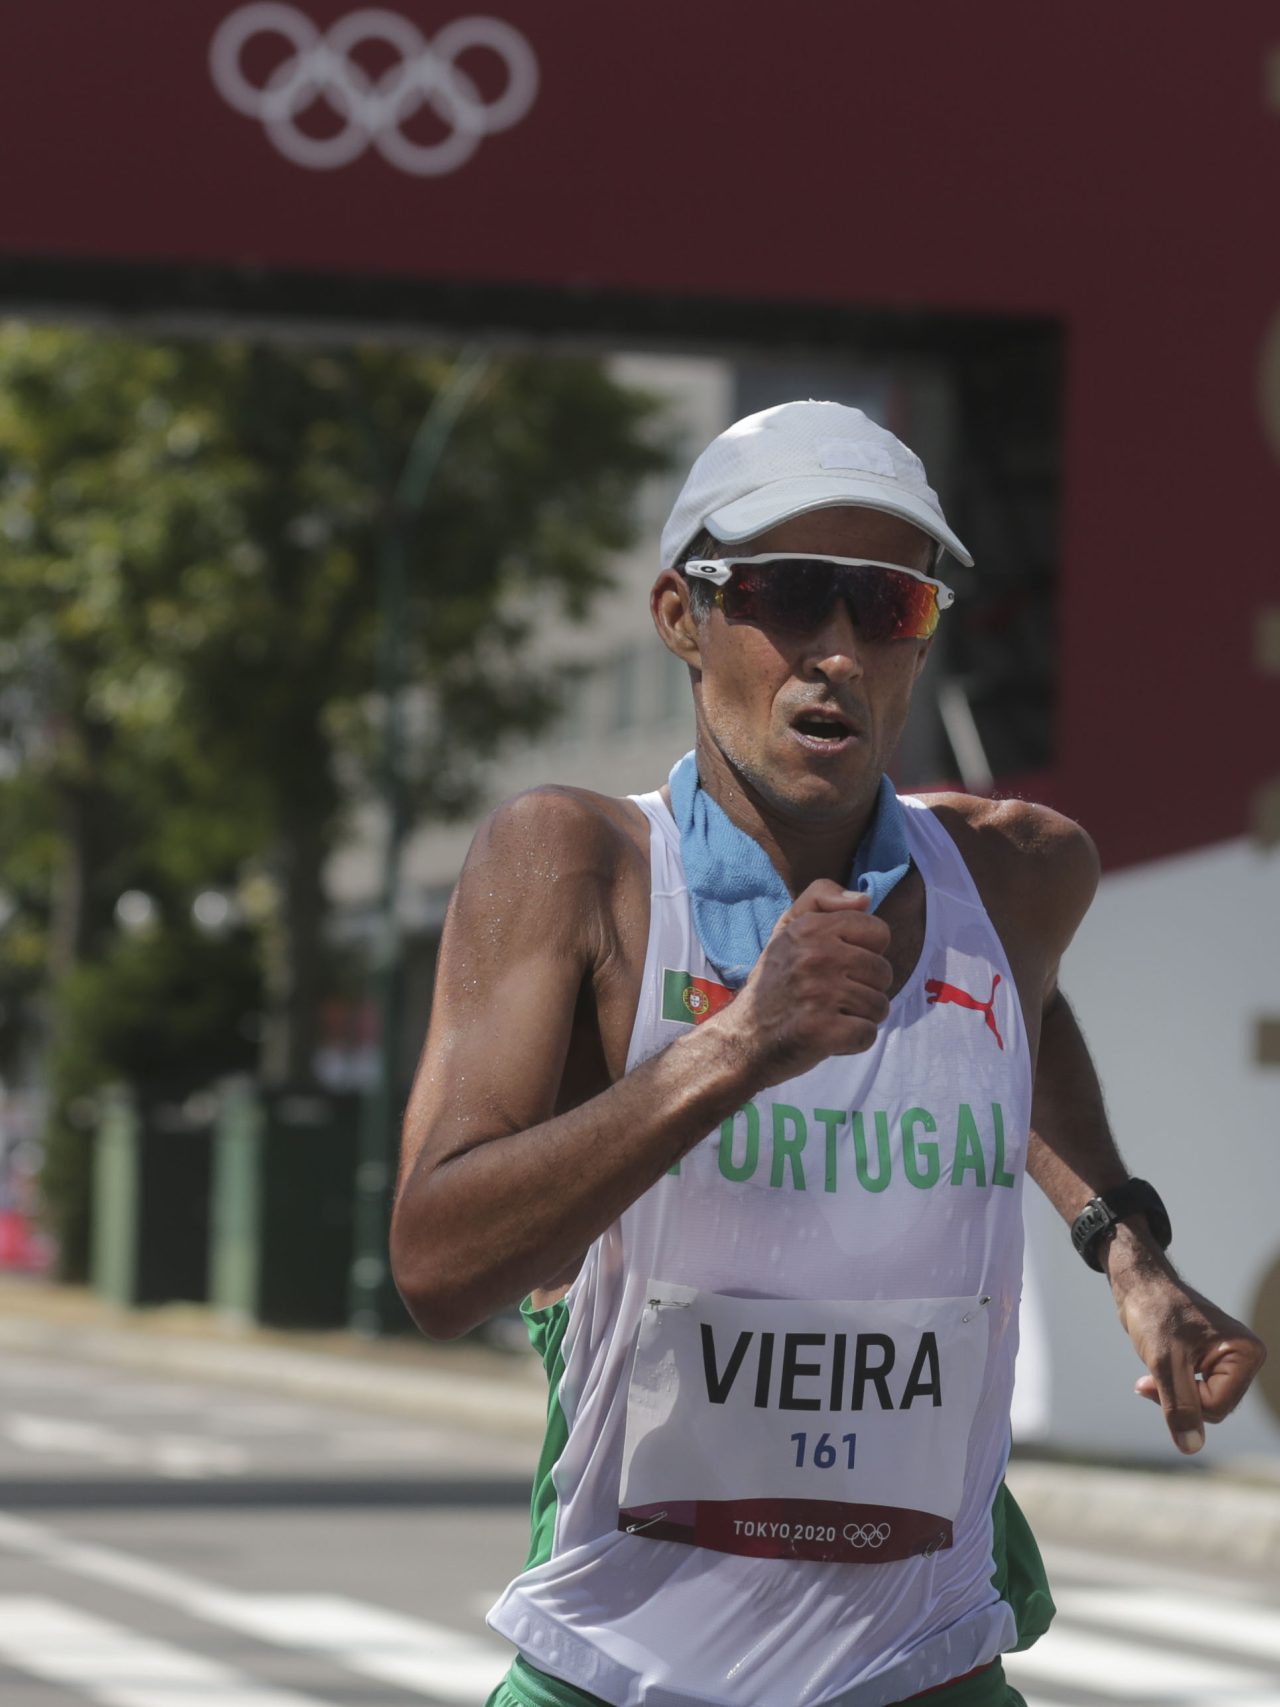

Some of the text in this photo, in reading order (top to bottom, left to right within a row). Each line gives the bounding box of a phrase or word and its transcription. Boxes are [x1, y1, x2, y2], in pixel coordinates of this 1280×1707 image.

[664, 1100, 1015, 1194] ORTUGAL
[700, 1323, 942, 1411] VIEIRA
[791, 1432, 857, 1470] 161
[733, 1520, 836, 1542] TOKYO 2020
